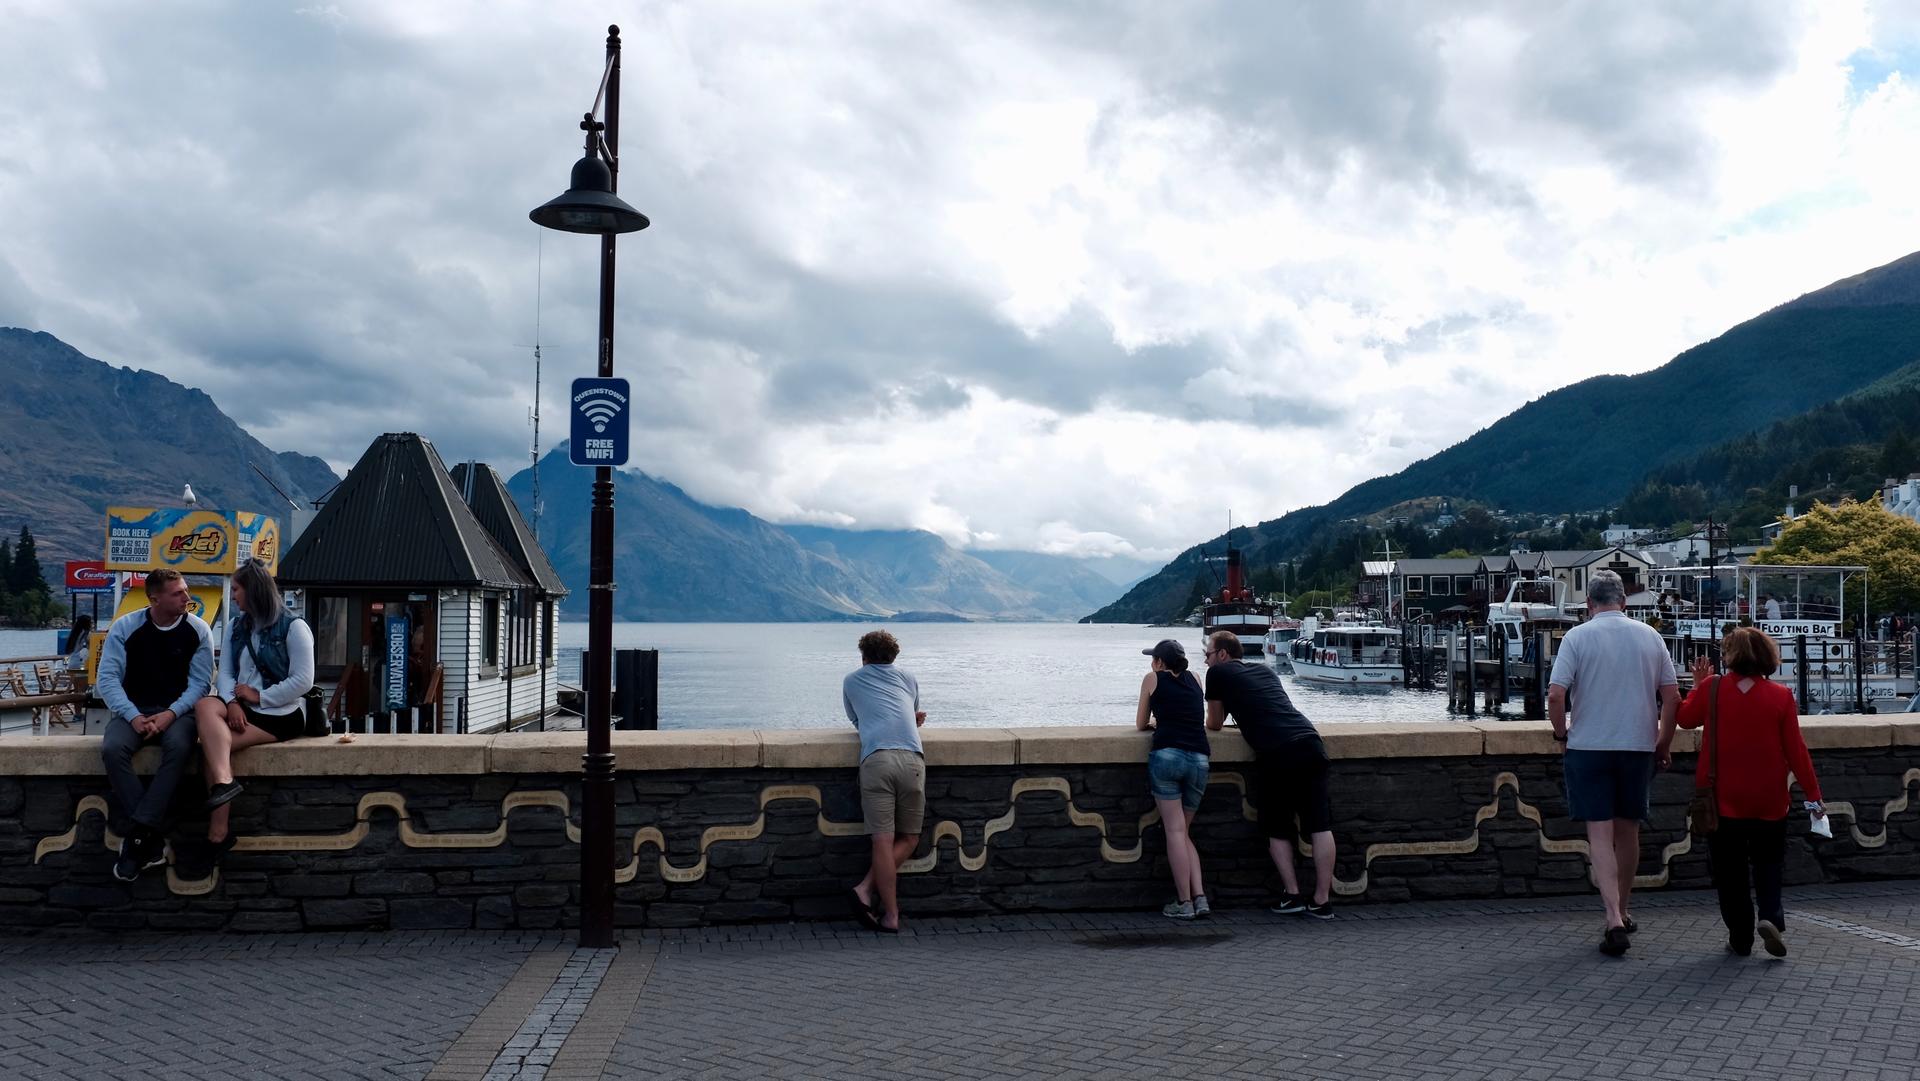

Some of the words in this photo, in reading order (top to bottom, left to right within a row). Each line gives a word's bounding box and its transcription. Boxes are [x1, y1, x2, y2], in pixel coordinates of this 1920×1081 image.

[574, 388, 627, 403] QUEENSTOWN
[585, 439, 614, 448] FREE
[586, 449, 614, 459] WIFI
[112, 528, 131, 537] BOOK
[131, 528, 150, 537] HERE
[390, 633, 404, 705] OBSERVATORY
